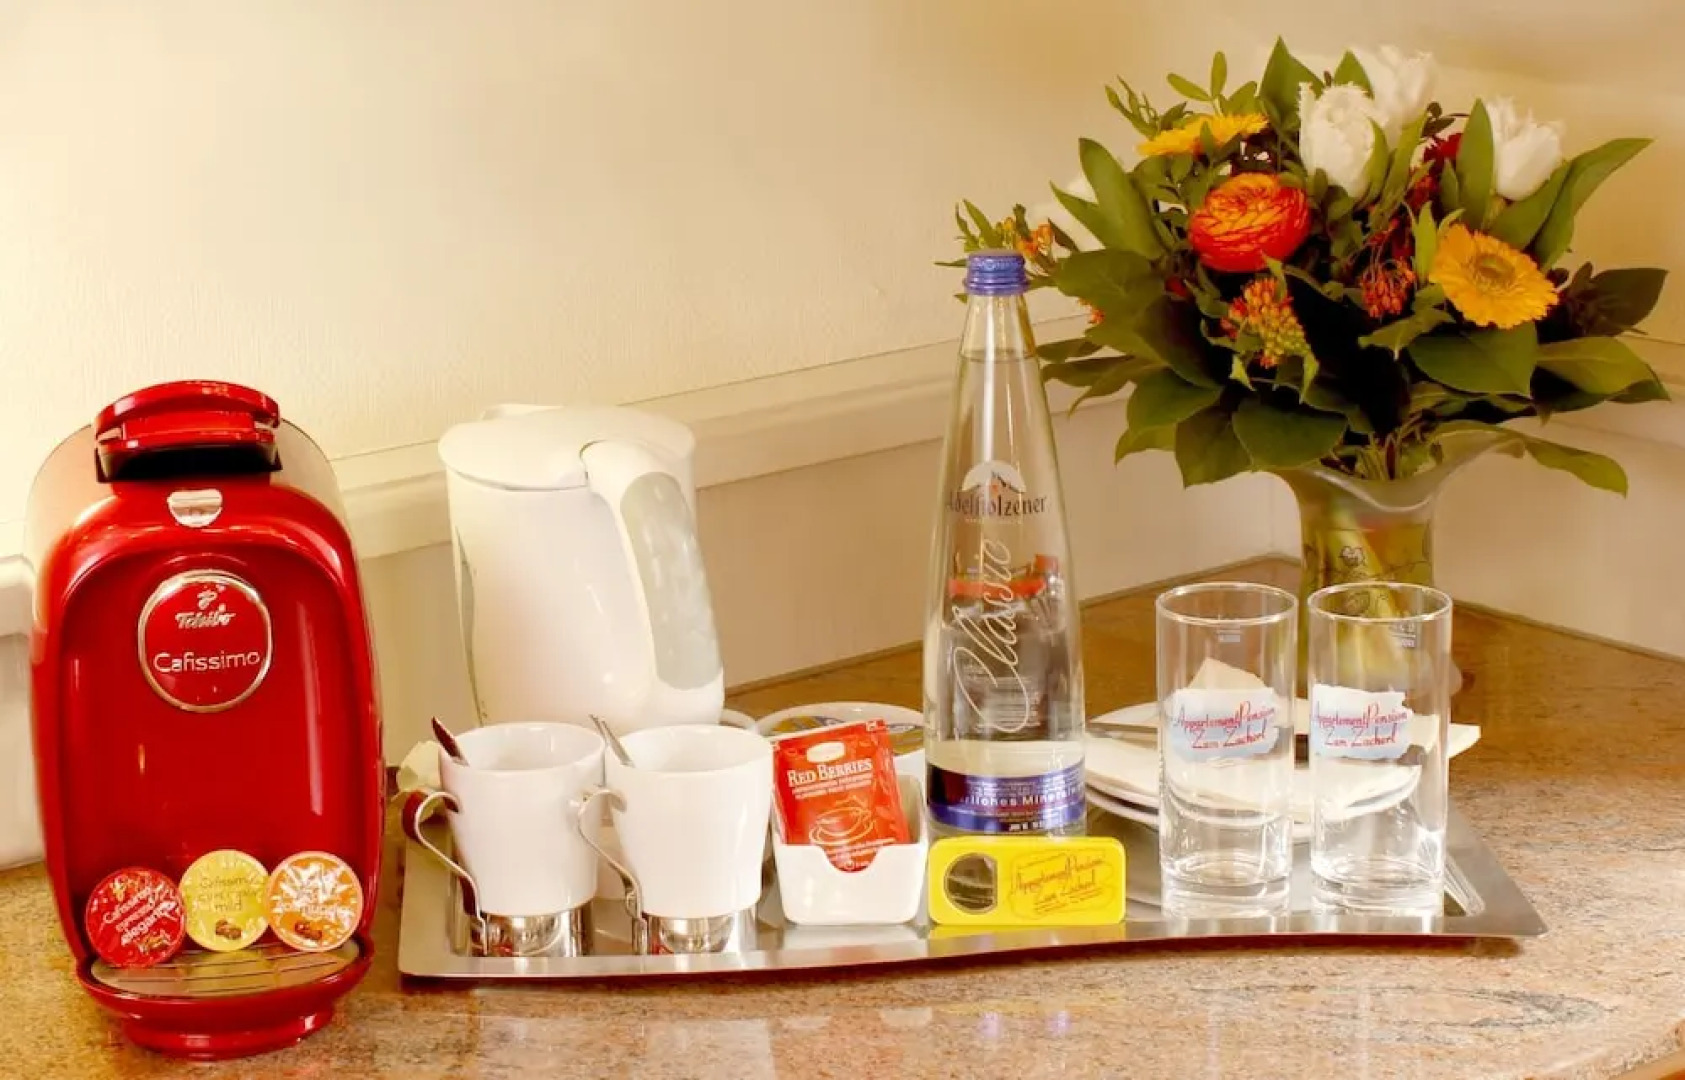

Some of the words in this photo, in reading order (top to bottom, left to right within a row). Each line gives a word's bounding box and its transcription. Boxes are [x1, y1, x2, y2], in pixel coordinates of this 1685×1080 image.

[154, 651, 260, 674] Cafissimo
[786, 769, 817, 788] RED
[816, 757, 873, 781] BERRIES
